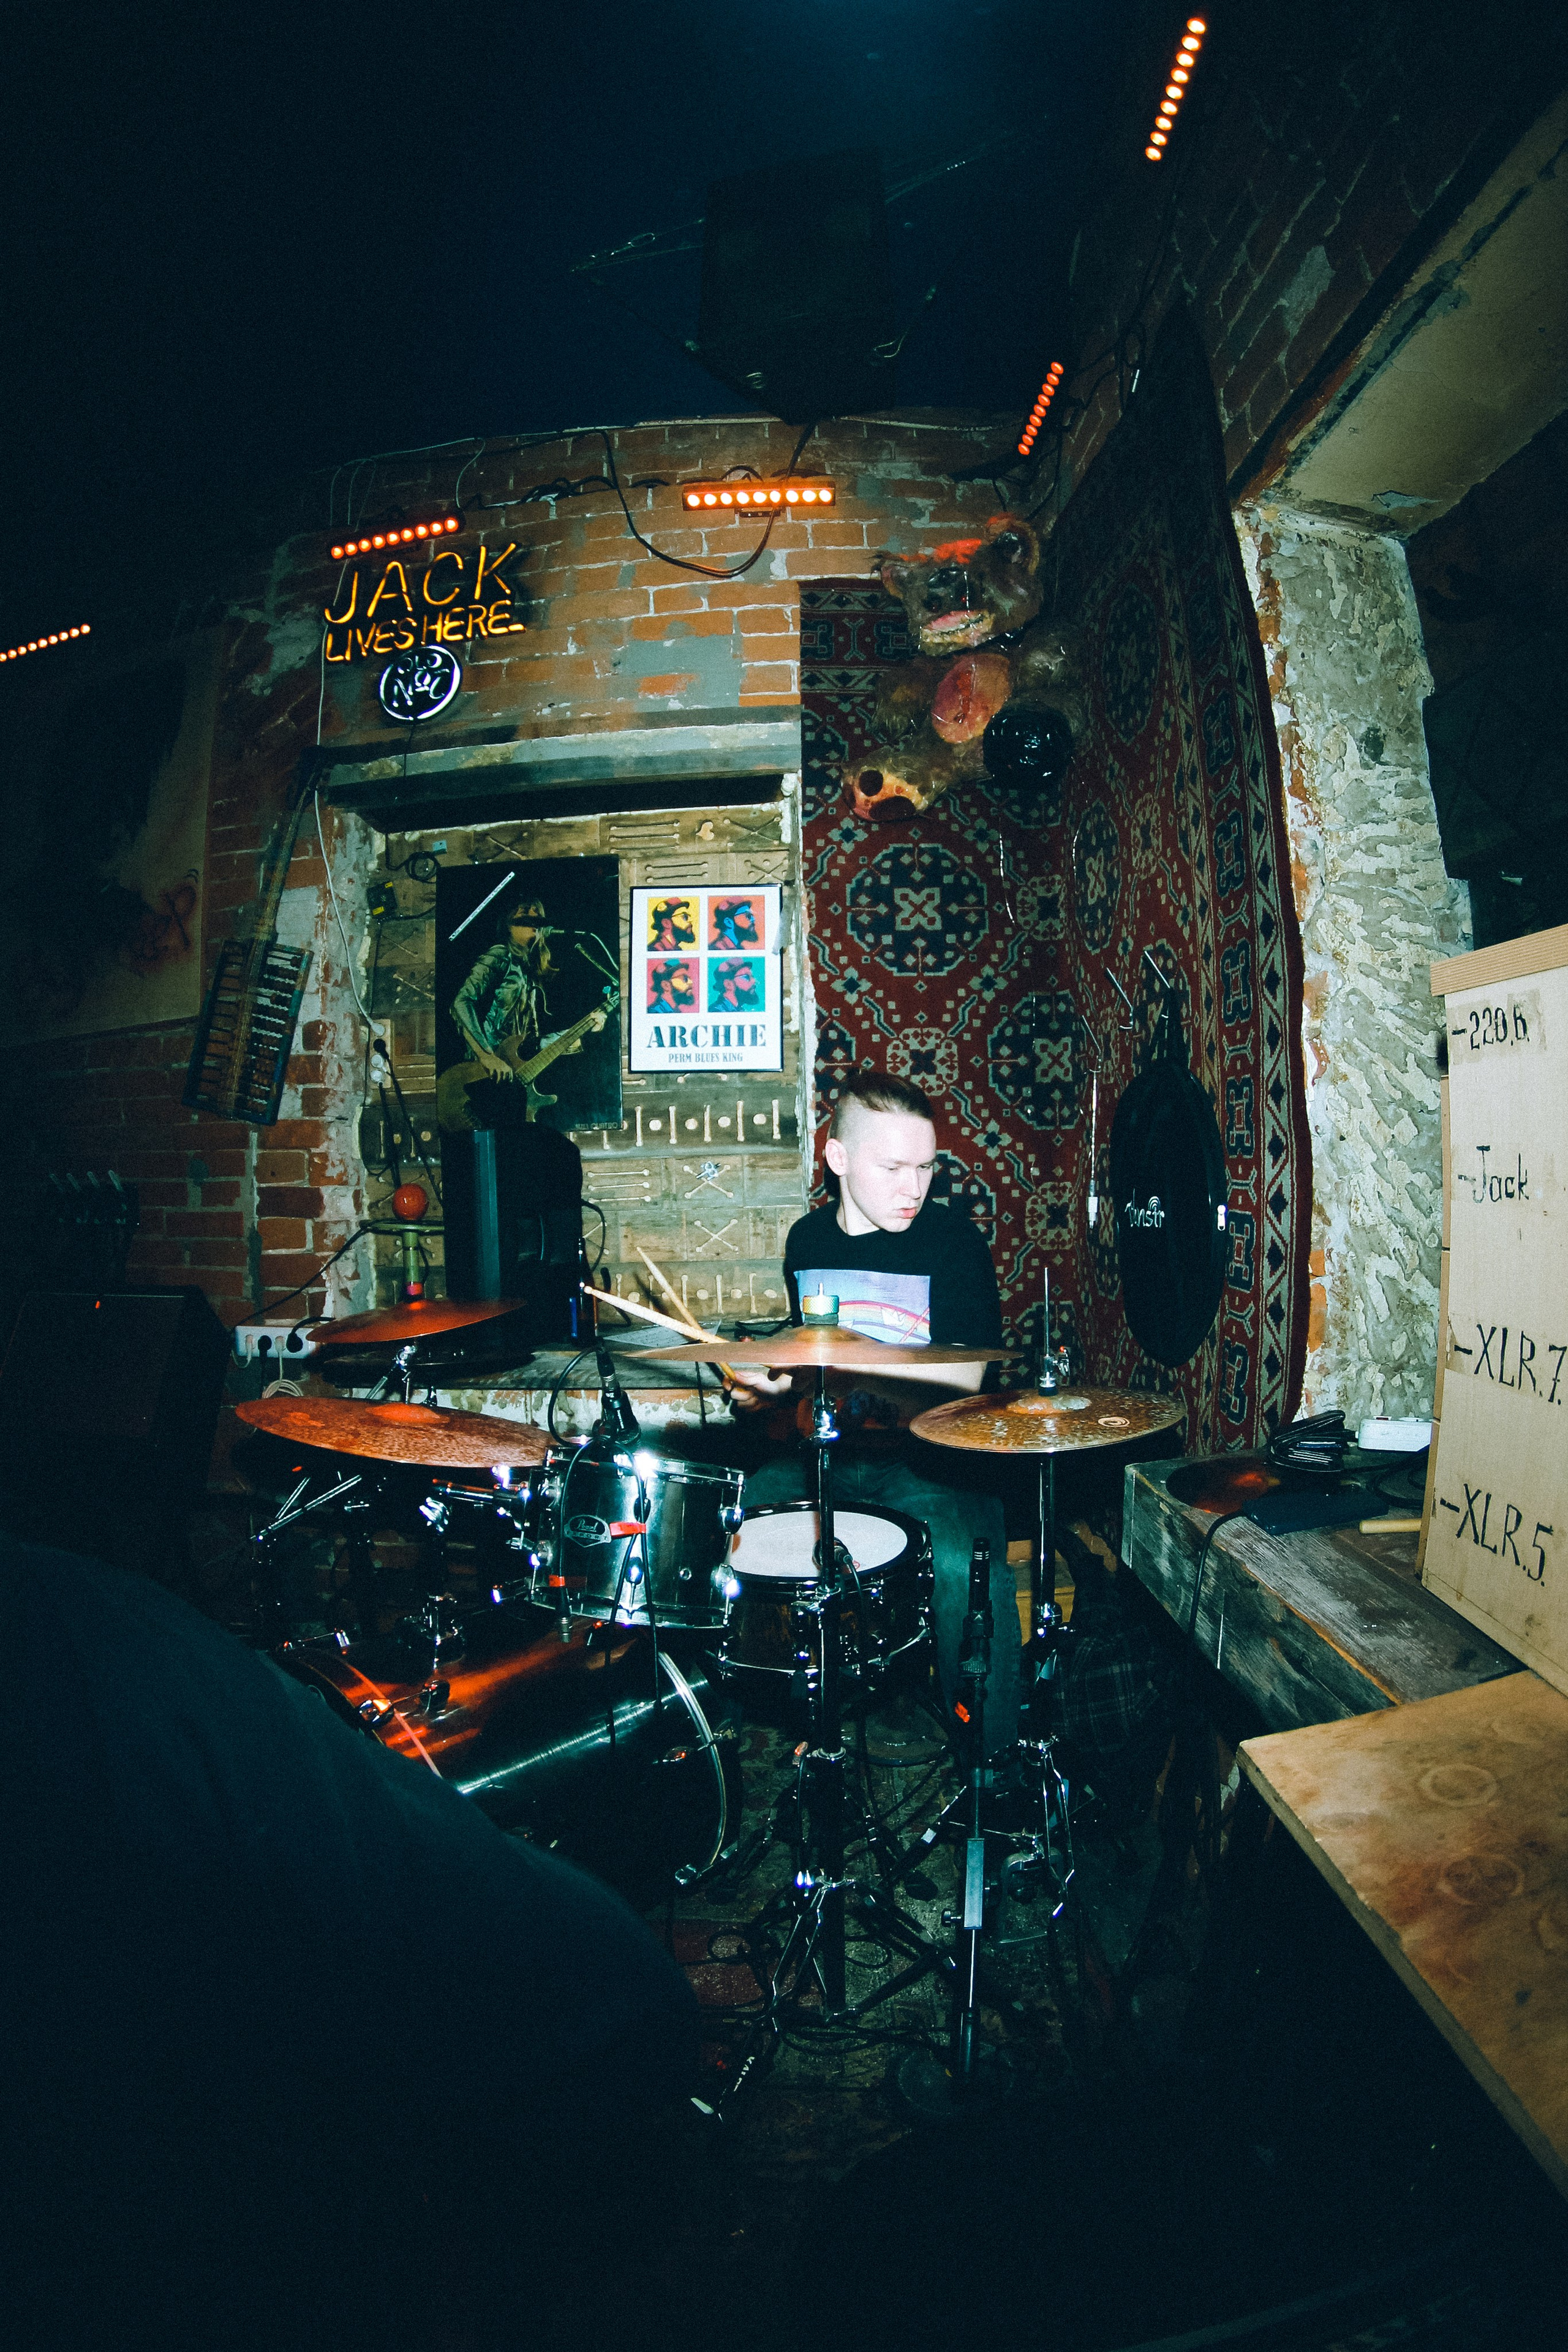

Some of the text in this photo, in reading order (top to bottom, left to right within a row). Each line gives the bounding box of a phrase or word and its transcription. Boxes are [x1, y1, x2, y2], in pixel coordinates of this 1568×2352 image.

[325, 543, 516, 624] JACK
[326, 599, 525, 662] LIVES HERE
[646, 1024, 766, 1048] ARCHIE
[668, 1052, 744, 1063] PERM BLUES KING
